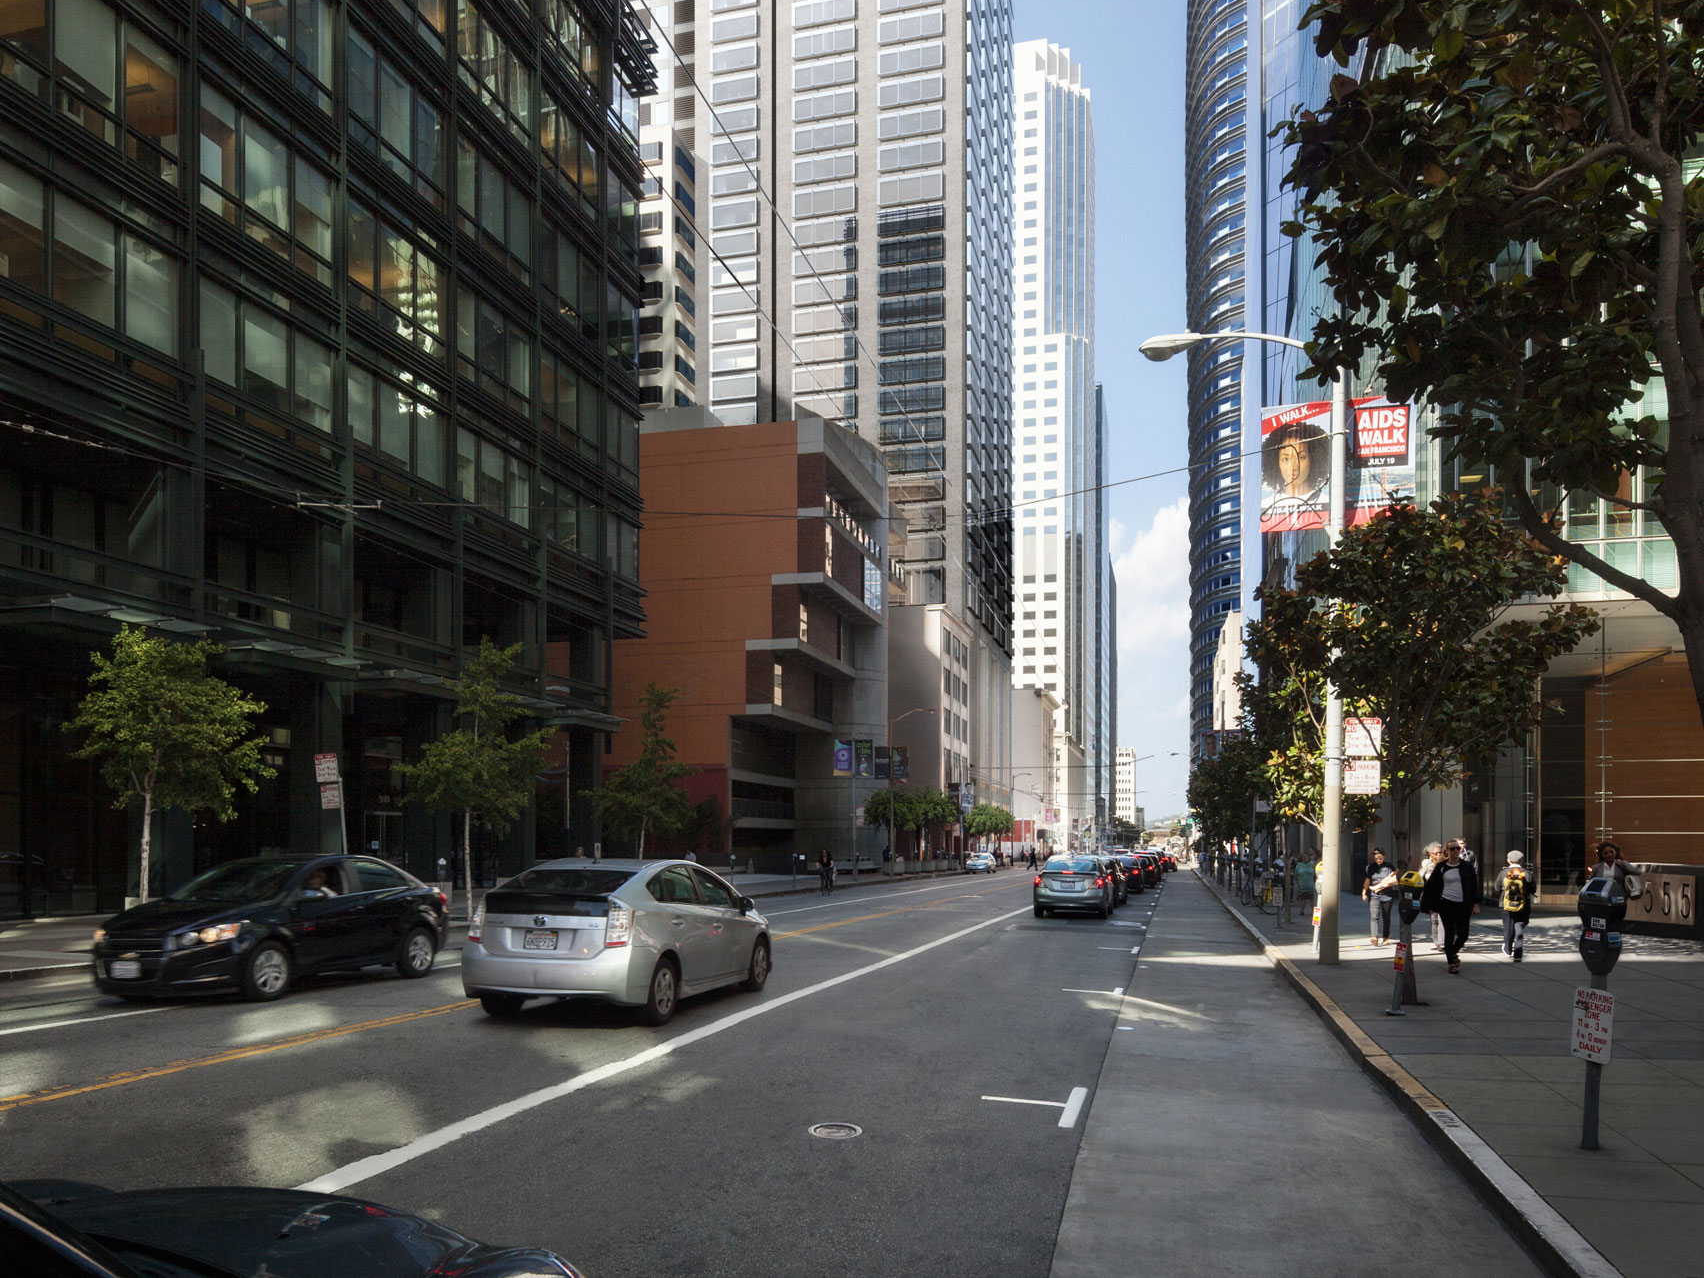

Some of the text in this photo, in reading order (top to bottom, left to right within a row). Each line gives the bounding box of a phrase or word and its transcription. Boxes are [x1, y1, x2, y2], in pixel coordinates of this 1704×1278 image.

[1271, 405, 1320, 427] I WALK...
[1358, 409, 1406, 430] AIDS
[1358, 429, 1405, 446] WALK
[1370, 445, 1405, 455] FRANCISCO
[1368, 457, 1396, 466] JULY 19
[1643, 880, 1691, 919] 555
[1577, 989, 1613, 1006] NO PARKING
[1584, 1011, 1601, 1021] ZONE
[1594, 1022, 1600, 1032] 3
[1579, 1042, 1603, 1054] DAILY
